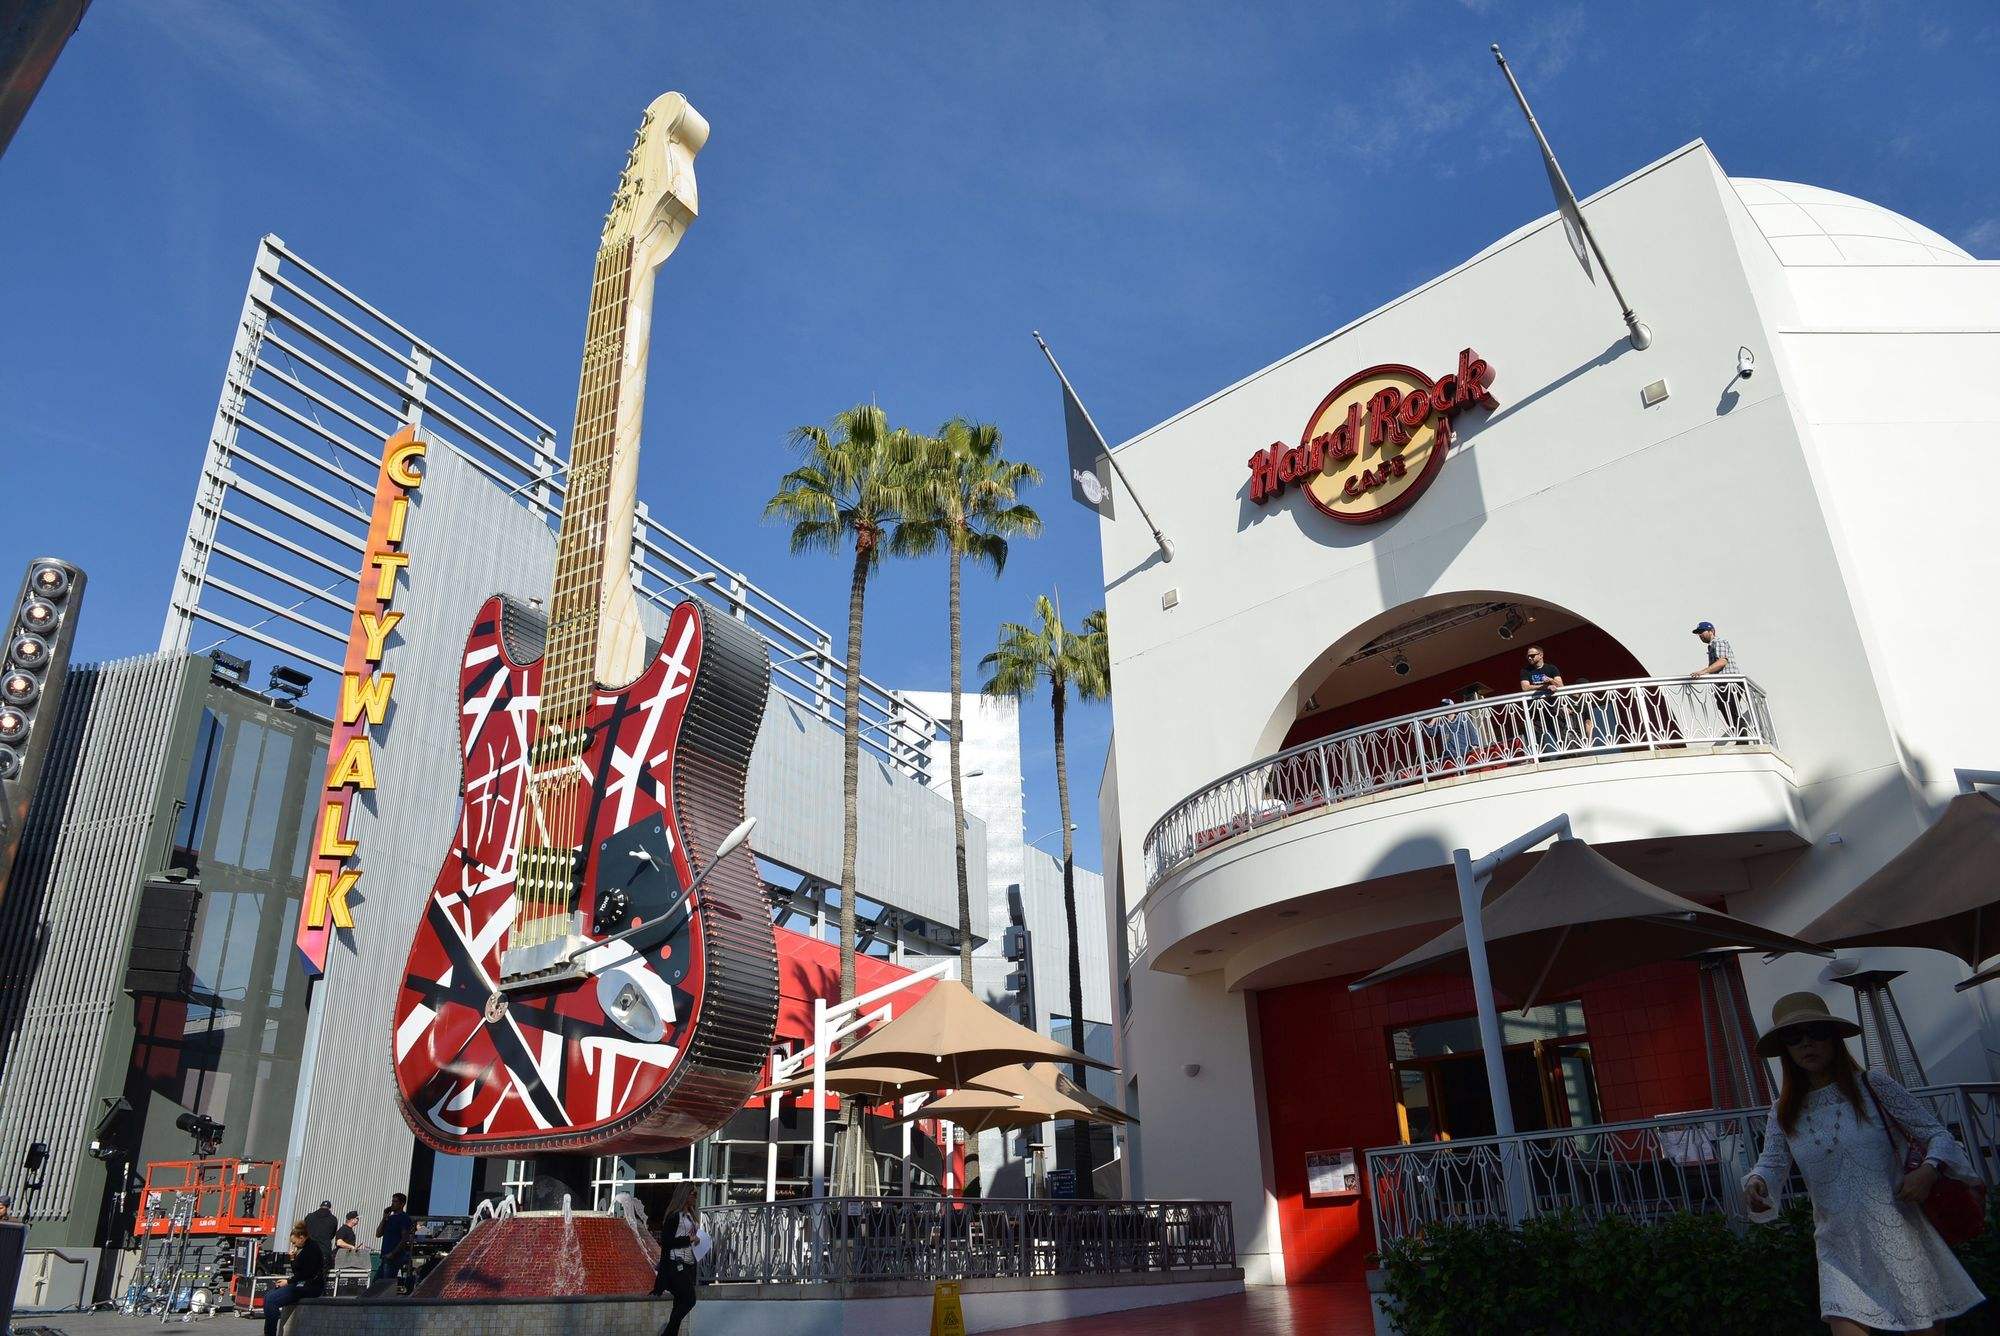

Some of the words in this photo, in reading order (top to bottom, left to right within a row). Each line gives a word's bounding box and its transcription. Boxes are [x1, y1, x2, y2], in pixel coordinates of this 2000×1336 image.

[1248, 401, 1363, 506] Hard
[1367, 347, 1500, 447] Rock
[1343, 454, 1408, 498] CAFE
[307, 441, 426, 929] CITYWALK
[599, 895, 610, 912] TONE
